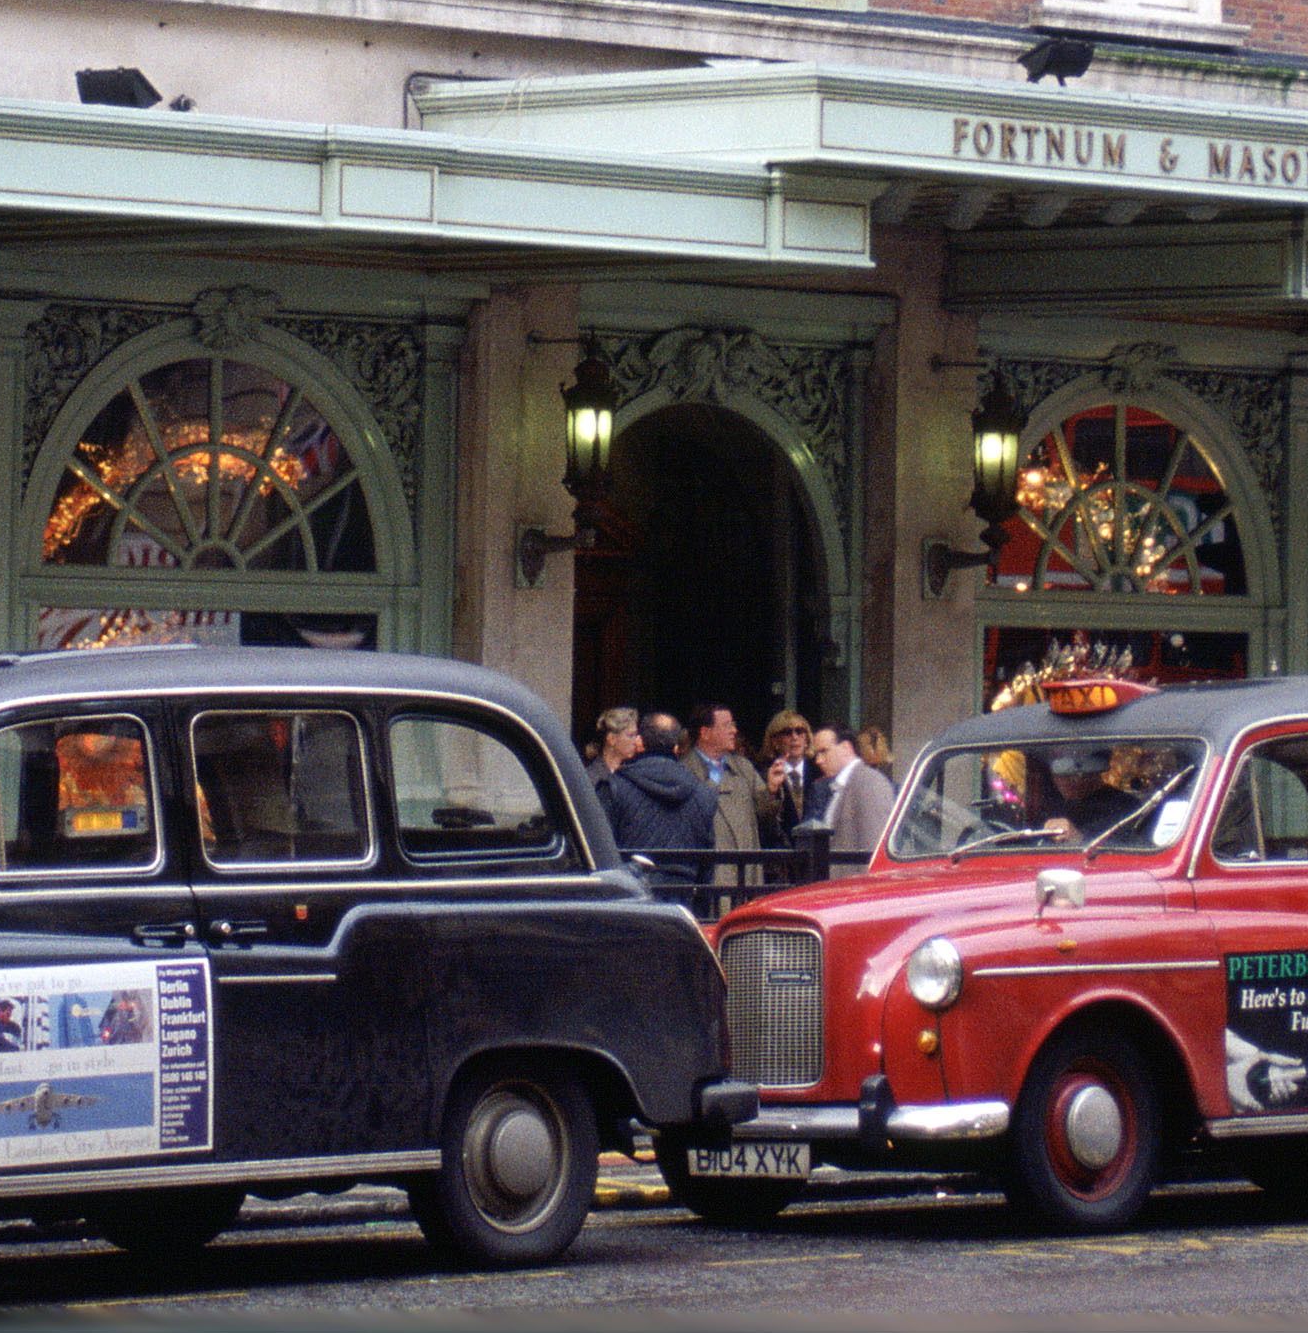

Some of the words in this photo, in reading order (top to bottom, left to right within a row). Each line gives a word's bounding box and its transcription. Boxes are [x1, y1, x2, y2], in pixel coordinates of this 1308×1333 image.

[953, 117, 1126, 170] FORTNUM
[1159, 137, 1178, 173] &
[160, 980, 189, 994] Berlin
[161, 996, 192, 1010] Dublin
[1241, 987, 1286, 1009] Here's
[1290, 986, 1305, 1006] to
[161, 1011, 206, 1025] Frankfurt
[162, 1029, 197, 1043] Lugano
[5, 1137, 58, 1160] London
[63, 1135, 94, 1156] City
[754, 1146, 801, 1174] XYK
